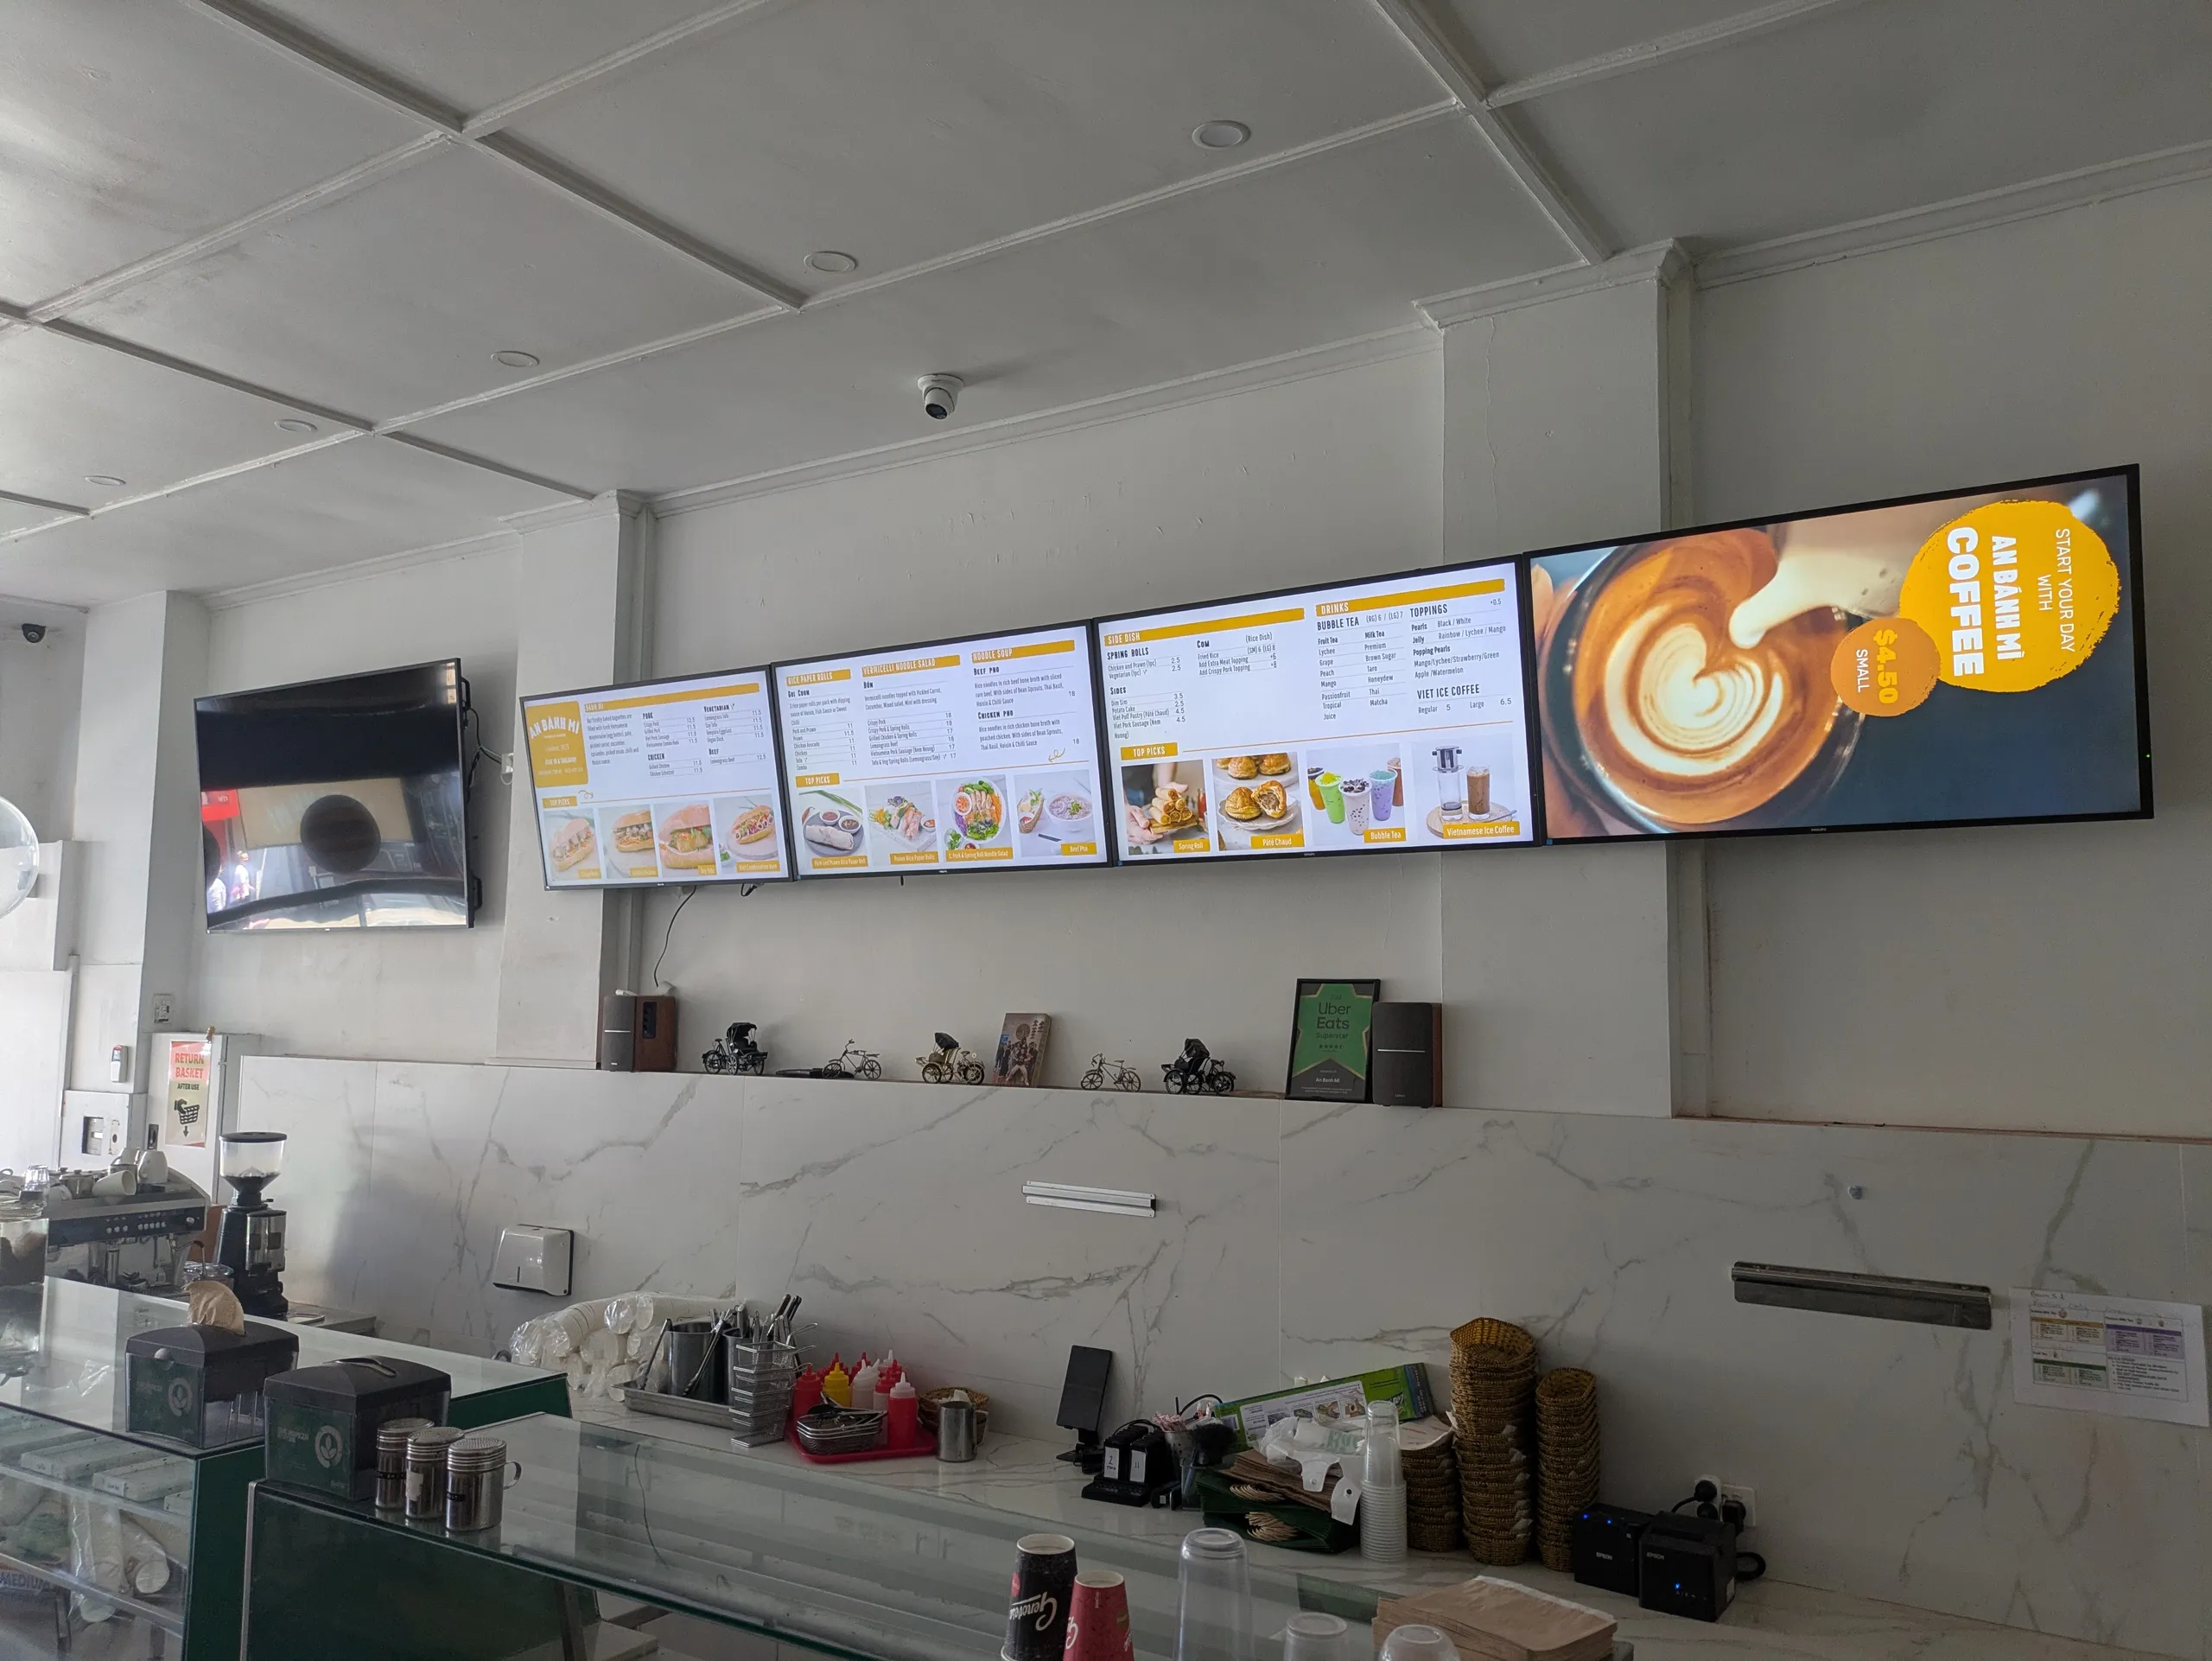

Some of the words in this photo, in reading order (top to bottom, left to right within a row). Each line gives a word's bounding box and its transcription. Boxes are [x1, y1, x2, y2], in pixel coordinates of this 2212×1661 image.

[1992, 535, 2018, 566] AN
[2055, 527, 2071, 575] START
[2037, 574, 2054, 611] WITH
[1946, 525, 1985, 677] COFFEE
[1993, 569, 2022, 629] BÁNH
[2056, 577, 2073, 621] YOUR
[1321, 601, 1349, 614] DRINKS
[1410, 603, 1447, 617] TOPPINGS
[1317, 619, 1344, 630] BUBBLE
[1346, 616, 1359, 627] TEA
[1108, 634, 1122, 644] SIDE
[1124, 632, 1140, 642] DISH
[1245, 633, 1258, 642] (Rice
[1259, 632, 1272, 640] Dish)
[1438, 630, 1460, 639] Rainbow
[1465, 627, 1483, 637] Lychee
[1488, 625, 1505, 634] Mango
[2058, 623, 2075, 652] DAY
[1412, 635, 1424, 644] Jelly
[973, 650, 995, 660] NOODLE
[996, 648, 1012, 658] SOUP
[1107, 650, 1128, 659] SPRING
[1131, 646, 1148, 657] ROLLS
[1319, 647, 1335, 657] Lychee
[1382, 652, 1396, 660] Sugar
[1413, 646, 1433, 656] Popping
[862, 663, 894, 674] VERMICELLI
[895, 660, 916, 670] NOODLE
[918, 658, 936, 667] SALAD
[1231, 656, 1248, 665] Topping
[1319, 659, 1333, 667] Grape
[1872, 628, 1898, 704] $4.50
[1233, 664, 1250, 672] Topping
[1414, 670, 1428, 678] Apple
[1855, 648, 1870, 693] SMALL
[800, 674, 817, 683] PAPER
[817, 671, 832, 680] ROLLS
[1109, 671, 1130, 679] Vegetarian
[1367, 674, 1393, 684] Honeydew
[1321, 691, 1351, 700] Passionfruit
[1417, 689, 1433, 699] VIET
[1436, 687, 1448, 697] ICE
[1451, 684, 1479, 696] COFFEE
[1322, 702, 1341, 710] Tropical
[1418, 705, 1437, 714] Regular
[1470, 701, 1484, 710] Large
[529, 722, 542, 740] AN
[1133, 748, 1145, 757] TOP
[1147, 746, 1165, 755] PICKS
[1447, 826, 1483, 835] Vietnamese
[1318, 1002, 1351, 1015] Uber
[1317, 1017, 1350, 1029] Eats
[175, 1053, 204, 1065] RETURN
[175, 1067, 204, 1079] BASKET
[1109, 1455, 1113, 1465] 2
[1595, 1551, 1613, 1561] EPSON
[1646, 1552, 1665, 1561] EPSON
